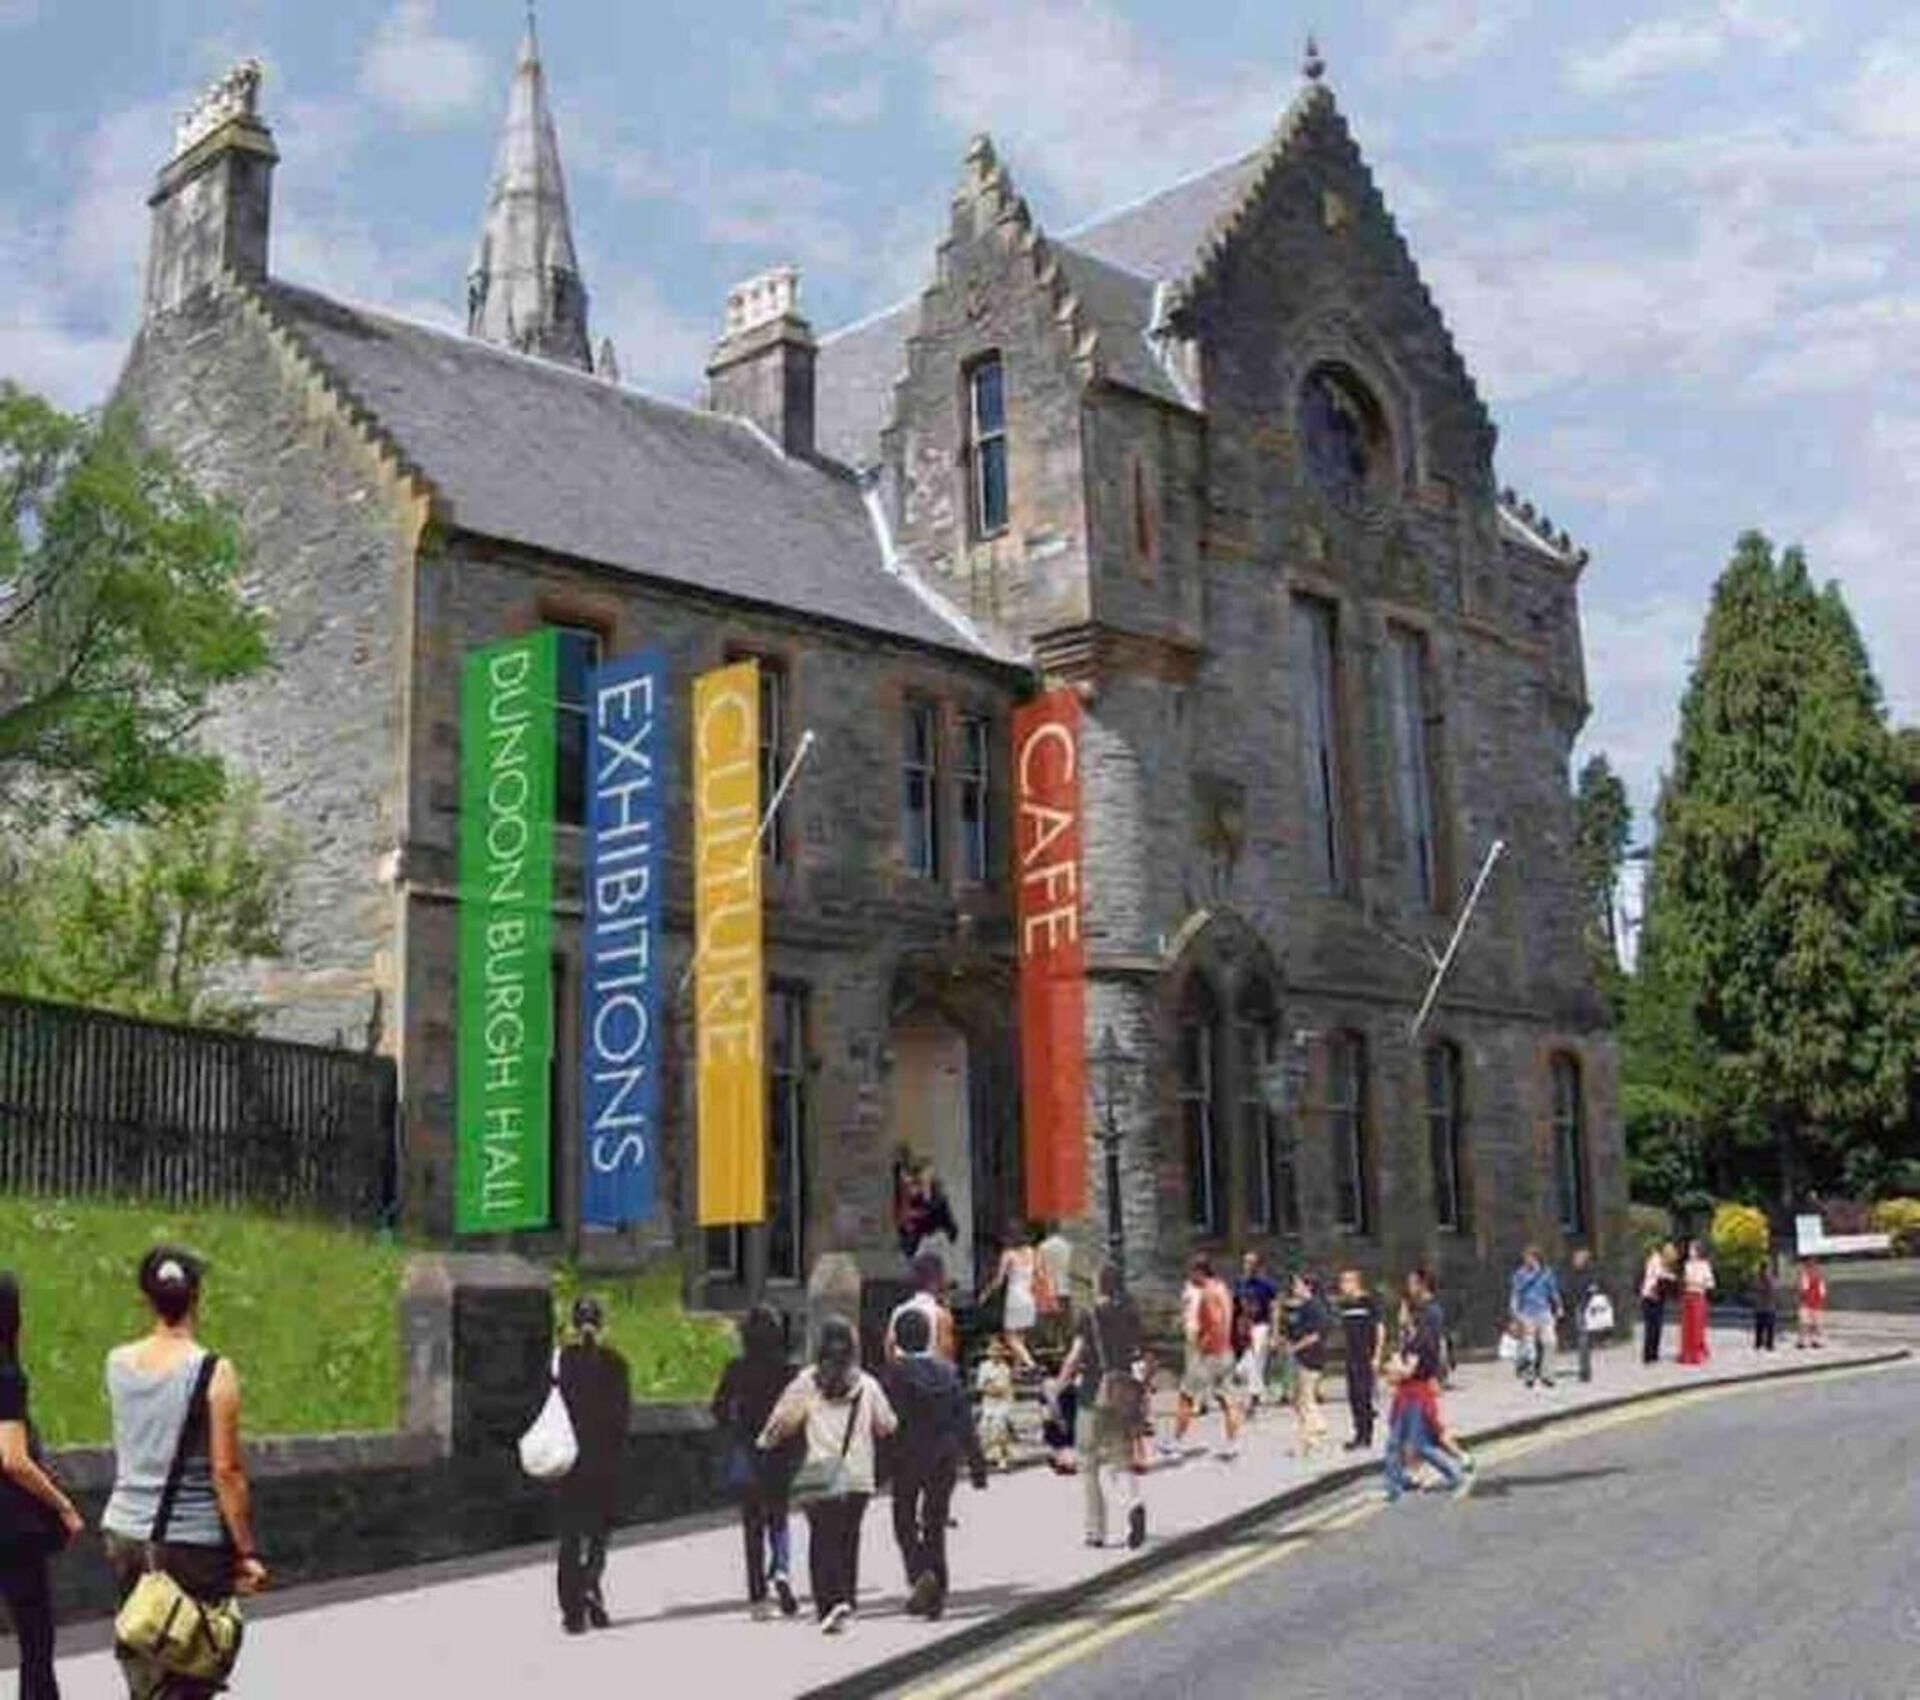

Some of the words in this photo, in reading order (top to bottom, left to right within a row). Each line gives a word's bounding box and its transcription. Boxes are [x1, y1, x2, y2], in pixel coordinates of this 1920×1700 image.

[487, 650, 531, 900] DUNOON
[699, 692, 756, 1063] CULTURE
[1020, 723, 1078, 954] CAFE
[484, 918, 525, 1091] BURGH
[594, 674, 652, 1171] EXHIBITIONS
[482, 1107, 523, 1216] HALL
